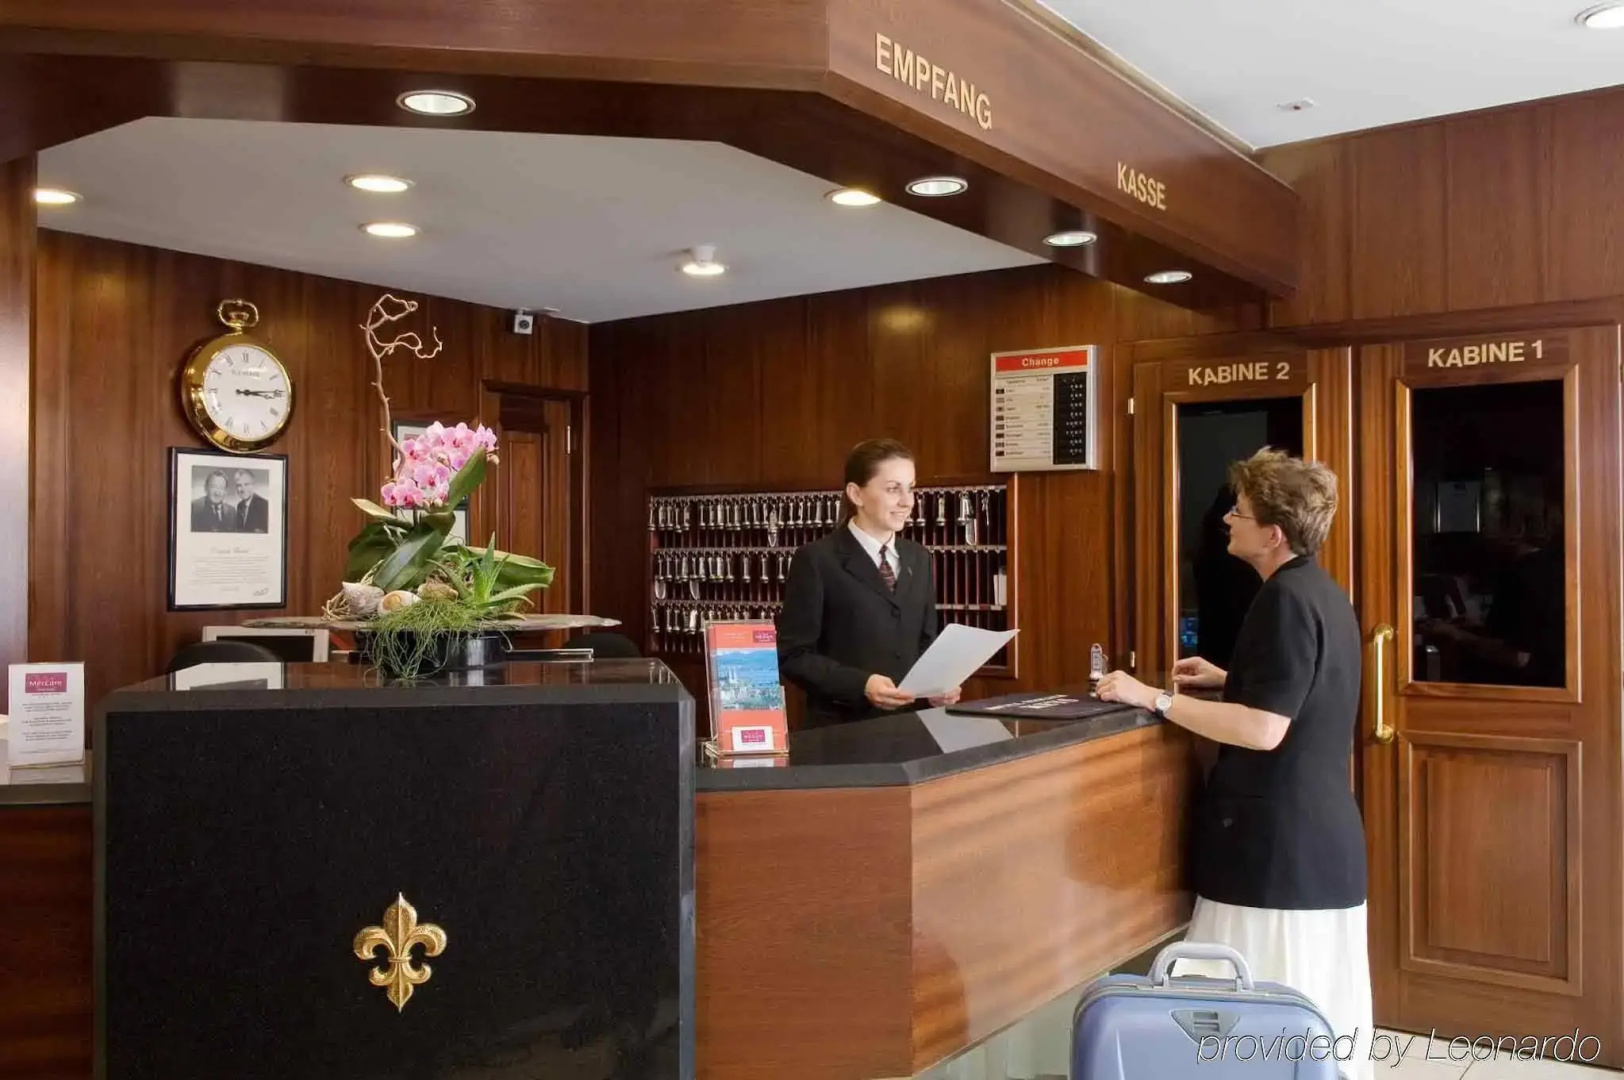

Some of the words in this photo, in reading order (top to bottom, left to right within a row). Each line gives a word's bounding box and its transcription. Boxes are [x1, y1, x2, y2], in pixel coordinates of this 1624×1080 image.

[875, 32, 993, 130] EMPFANG
[1117, 161, 1168, 211] KASSE
[1021, 357, 1060, 369] Change
[1427, 342, 1526, 369] KABINE
[1531, 339, 1545, 359] 1
[1187, 363, 1269, 386] KABINE
[1276, 361, 1291, 380] 2
